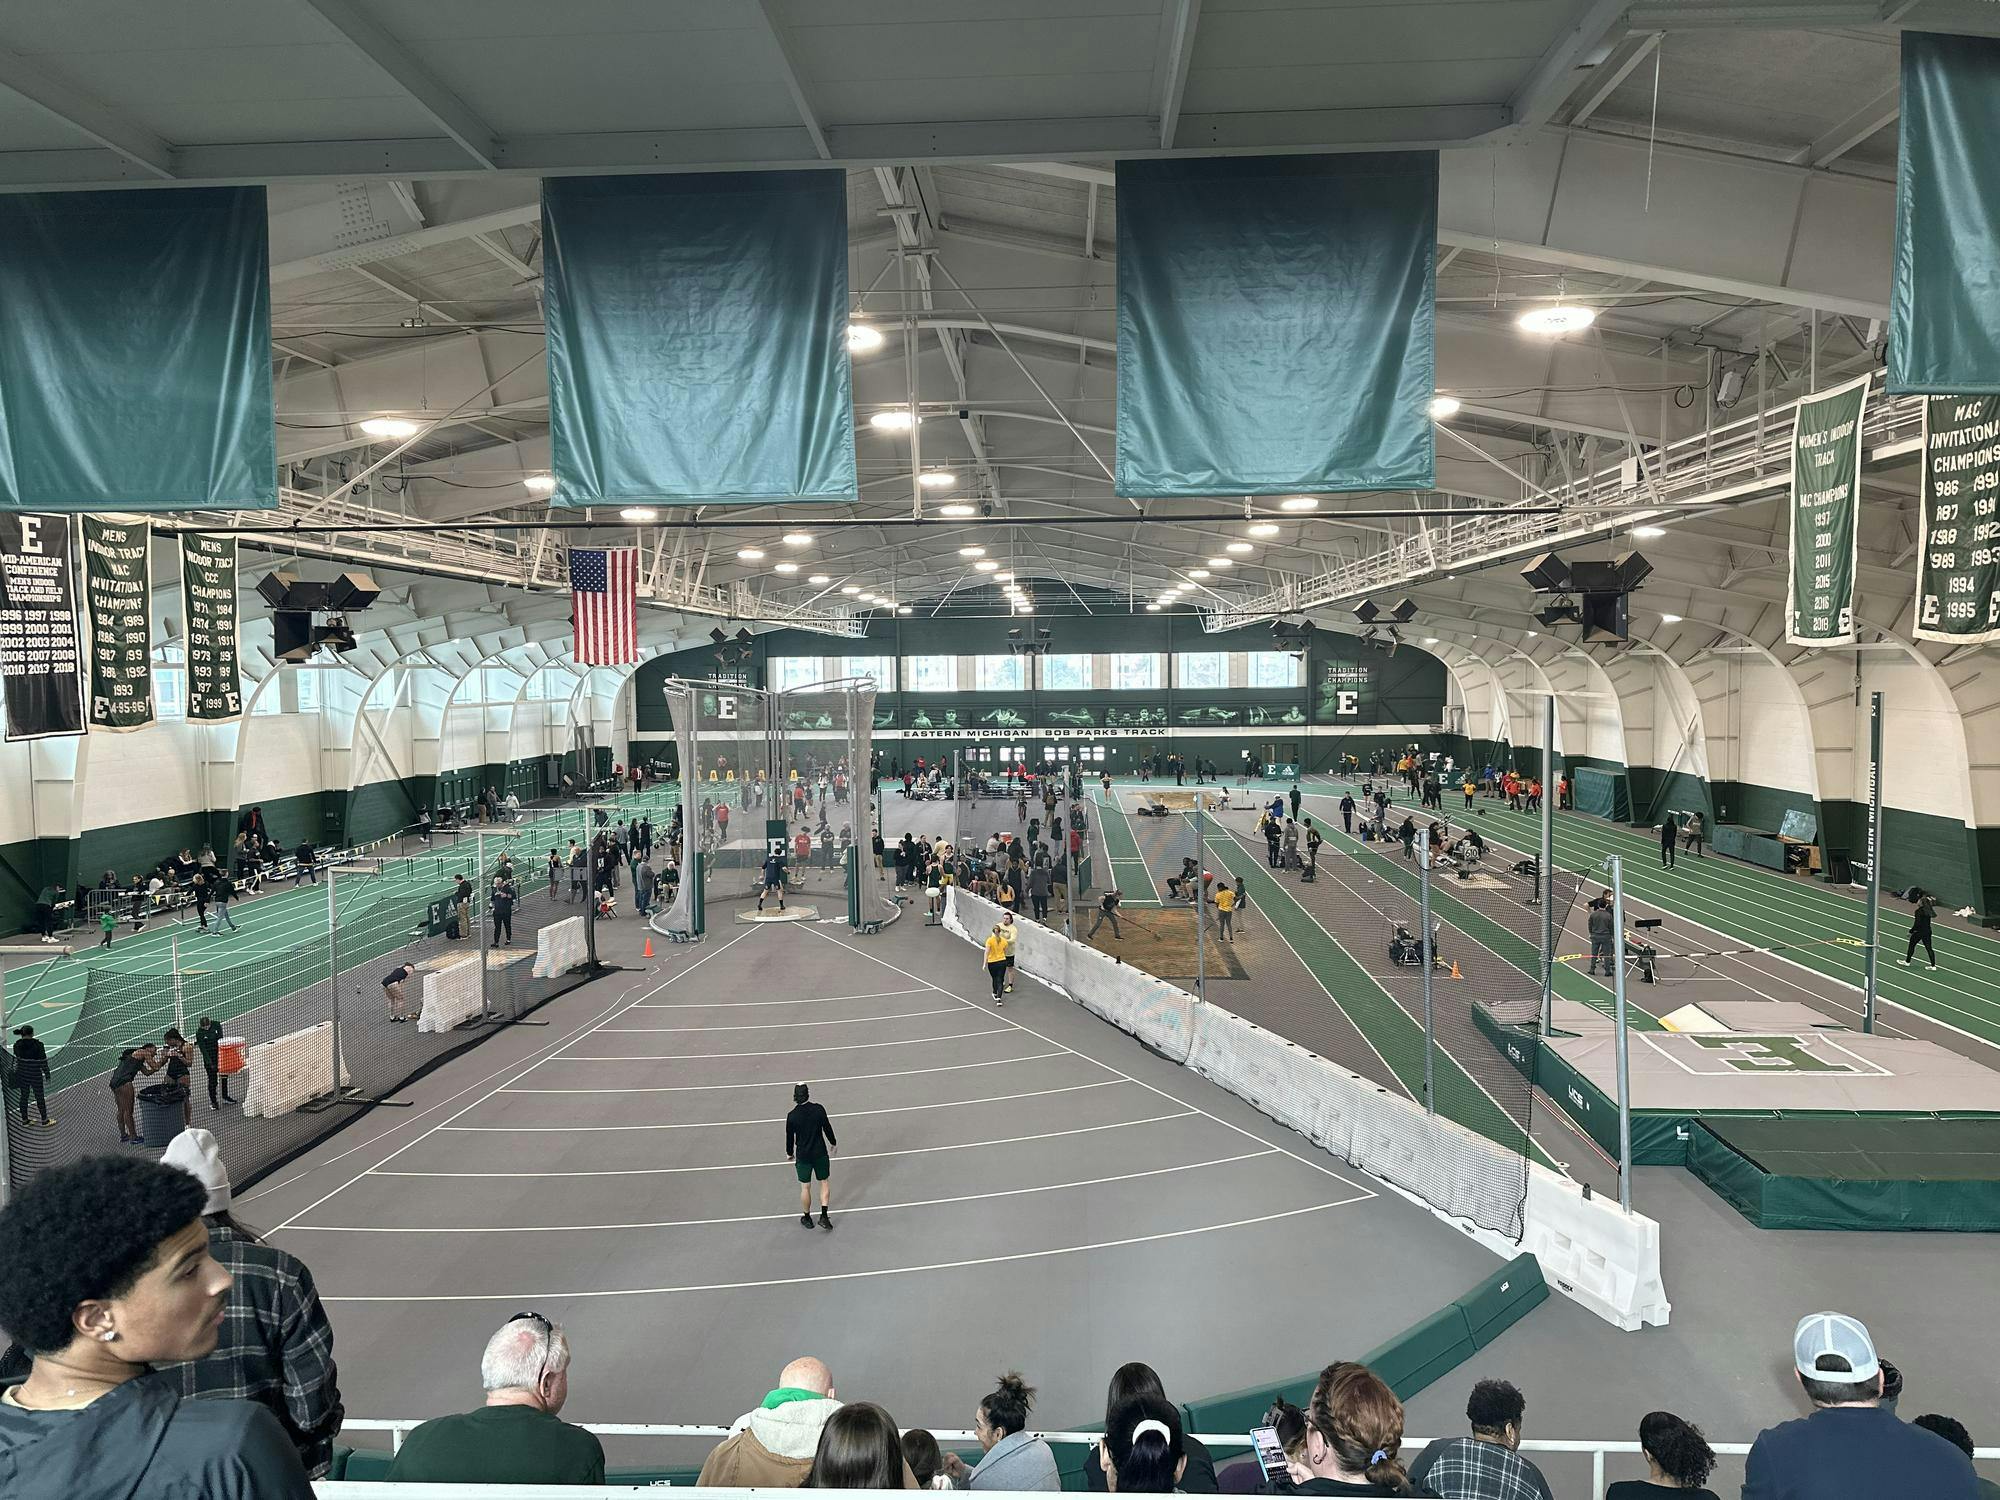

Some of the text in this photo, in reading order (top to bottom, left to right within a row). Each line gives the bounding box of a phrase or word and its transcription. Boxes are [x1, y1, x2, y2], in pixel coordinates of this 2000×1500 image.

[1954, 401, 1982, 421] MAC
[1800, 430, 1828, 448] WOMEN'S
[1815, 449, 1835, 468] TRACK
[1934, 444, 2000, 473] CHAMPIONS
[1815, 511, 1830, 527] 1997
[19, 516, 43, 554] E
[1815, 533, 1831, 548] 2000
[0, 553, 63, 567] MID-AMERICAN
[1815, 553, 1831, 569] 2011
[5, 564, 58, 577] CONFERENCE
[205, 571, 219, 584] CCC
[1815, 574, 1831, 589] 2015
[1949, 576, 1975, 594] 1994
[30, 586, 45, 594] AND
[192, 584, 232, 600] CHAMPIONS
[24, 609, 47, 621] 1997
[49, 610, 71, 621] 1998
[1921, 594, 1940, 625] E
[1947, 601, 1976, 618] 1995
[25, 623, 49, 635] 2000
[51, 623, 73, 635] 2001
[1813, 616, 1829, 632] 2018
[1, 636, 74, 648] 2002 2003 2004
[2, 649, 75, 662] 2006 2007 2008
[4, 664, 26, 676] 2010
[28, 663, 50, 675] 2013
[113, 684, 133, 696] 1993
[94, 695, 110, 719] E
[110, 701, 146, 714] 4-95-96
[191, 691, 240, 713] E 1999 E
[718, 696, 738, 720] E
[1337, 691, 1358, 715] E
[904, 729, 1029, 738] EASTERN MICHIGAN
[1124, 728, 1166, 736] TRACK
[1268, 764, 1276, 775] E
[1439, 773, 1448, 785] E
[768, 837, 786, 857] E
[1465, 848, 1478, 857] 610
[1568, 1084, 1583, 1106] UCS
